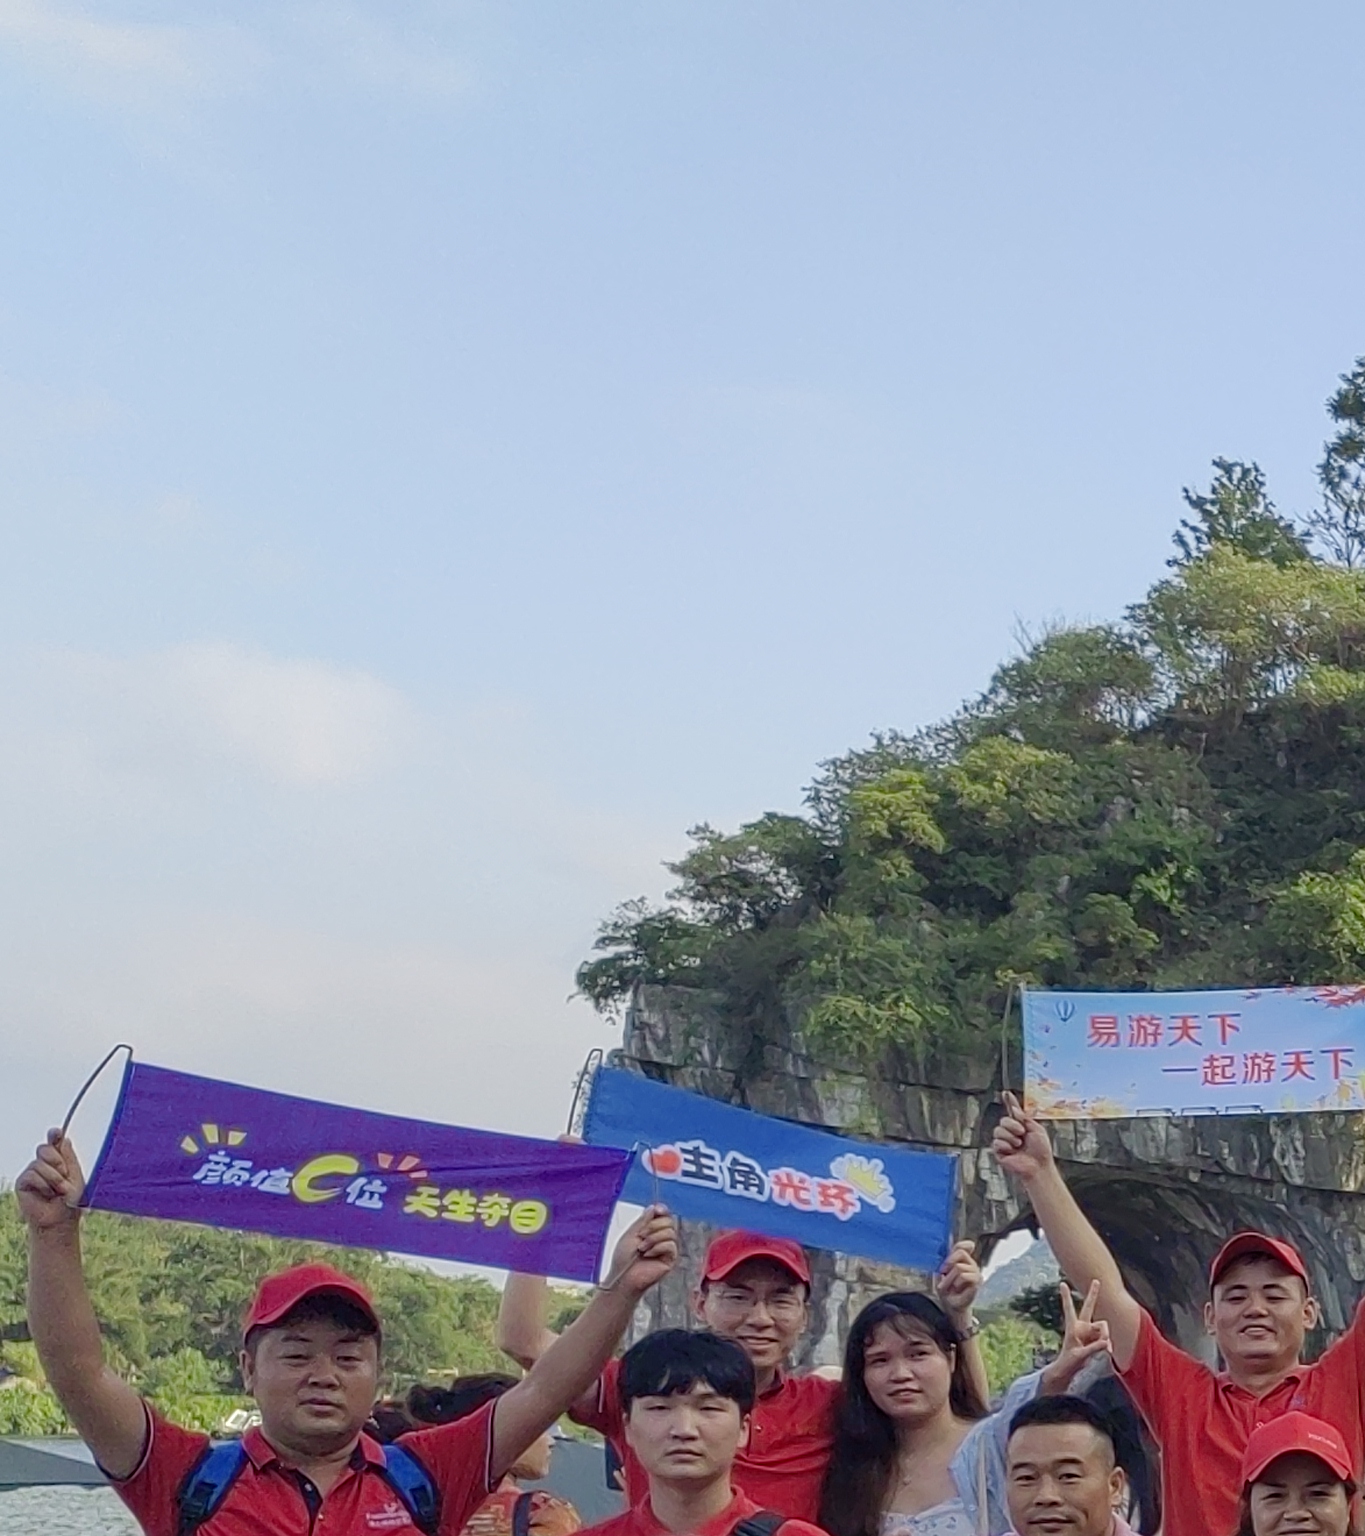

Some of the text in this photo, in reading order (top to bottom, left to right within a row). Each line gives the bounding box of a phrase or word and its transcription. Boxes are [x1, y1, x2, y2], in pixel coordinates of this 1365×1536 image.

[1086, 1012, 1242, 1048] 易游天下
[1161, 1047, 1356, 1087] 一起游天下
[192, 1150, 548, 1235] 颜值C位 天生夺目
[679, 1142, 860, 1216] 主角光环
